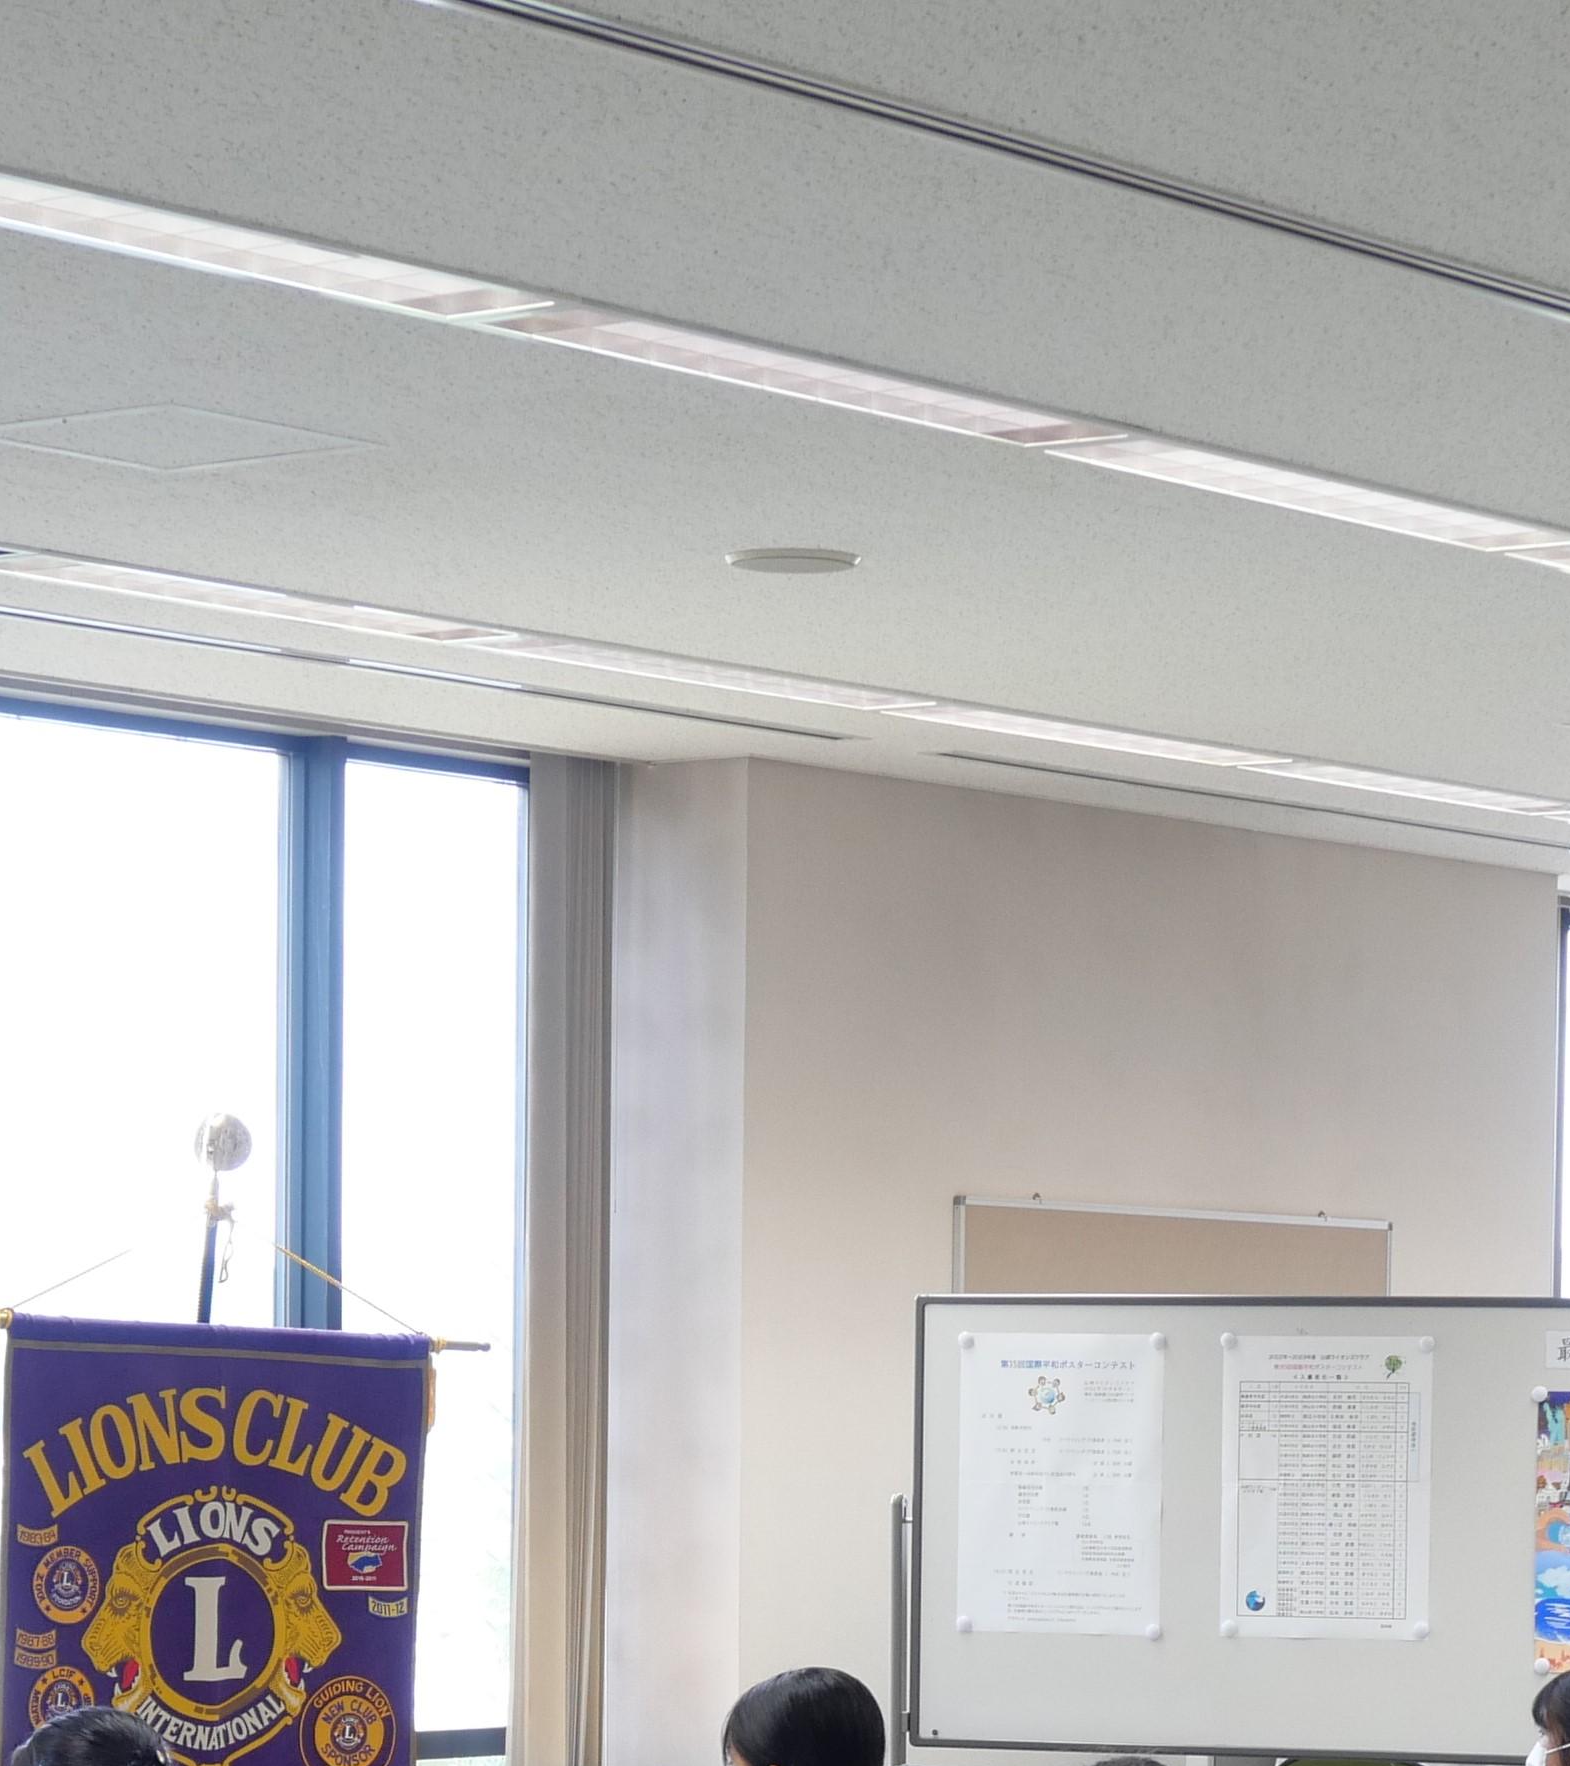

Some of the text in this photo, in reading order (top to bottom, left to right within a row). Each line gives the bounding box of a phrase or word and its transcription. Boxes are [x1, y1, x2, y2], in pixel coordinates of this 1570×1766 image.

[23, 1386, 407, 1517] LIONS CLUB
[147, 1501, 281, 1557] LIONS
[336, 1535, 390, 1543] Retention
[43, 1548, 81, 1568] MEMBER
[183, 1577, 248, 1681] L
[52, 1669, 75, 1679] LCIF
[313, 1680, 392, 1719] GUIDING LION
[322, 1699, 377, 1725] NEW CLUB
[136, 1694, 287, 1751] INTERNATIONAL
